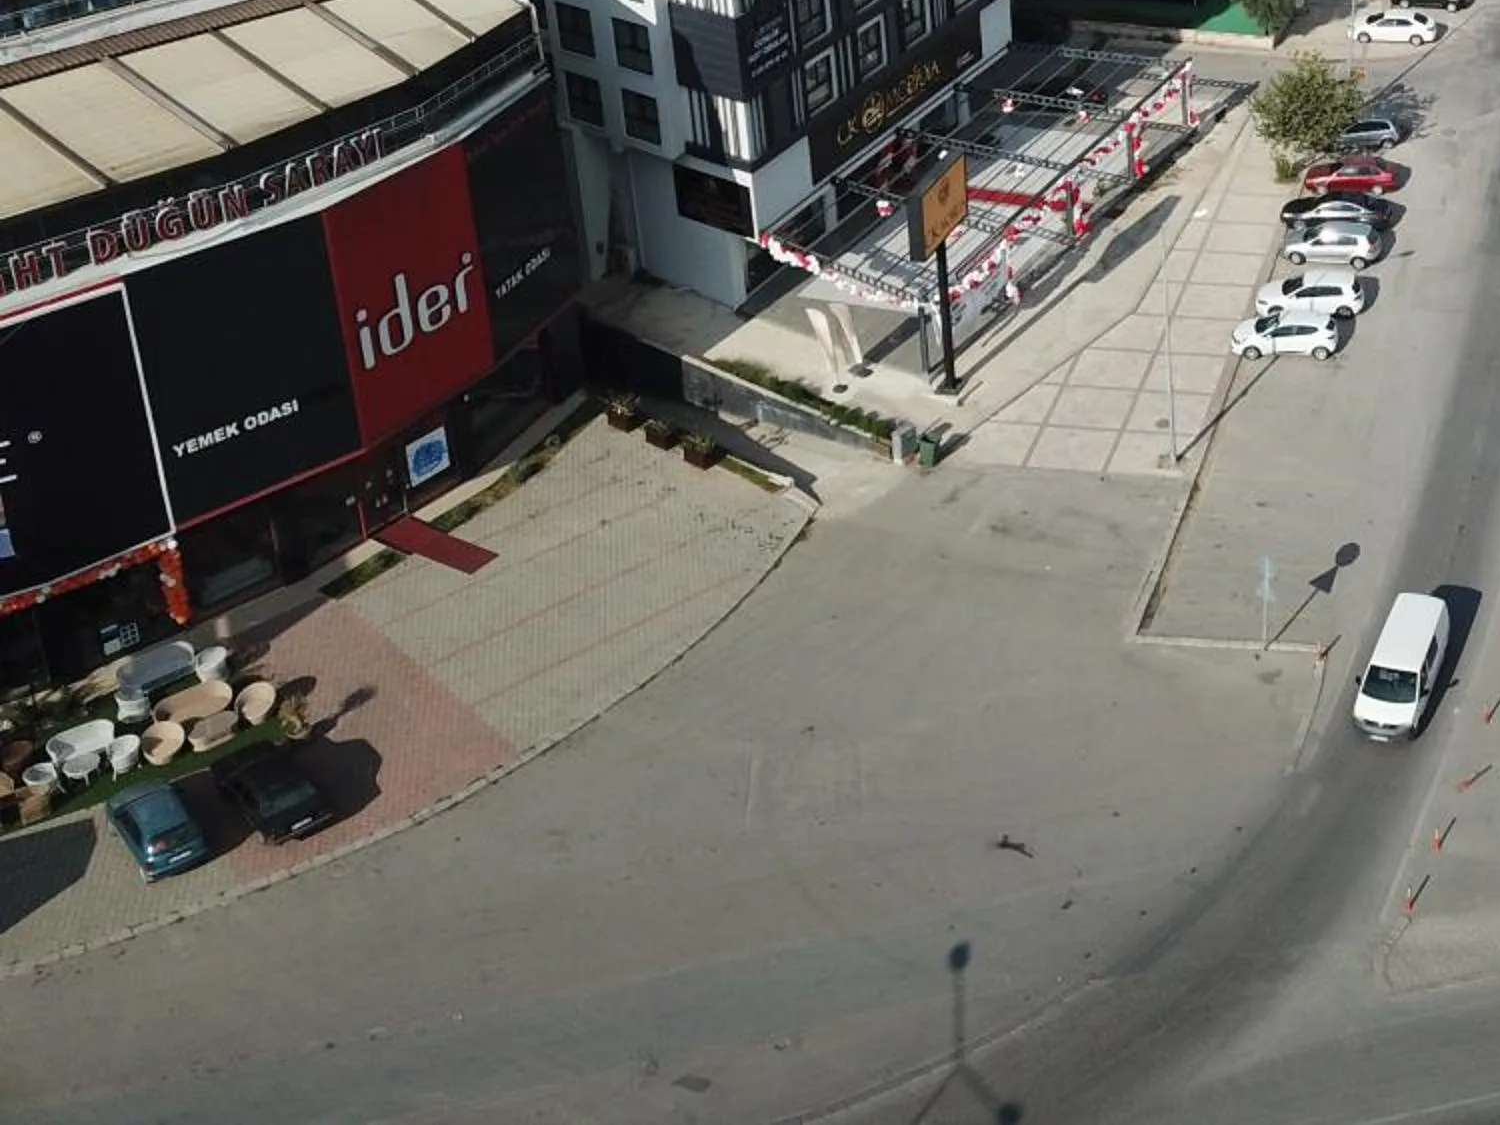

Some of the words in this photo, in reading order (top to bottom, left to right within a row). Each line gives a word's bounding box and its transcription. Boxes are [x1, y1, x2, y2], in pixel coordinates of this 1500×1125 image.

[87, 188, 251, 266] DÜĞÜN
[259, 127, 386, 208] SARAYI
[171, 422, 240, 459] YEMEK
[243, 398, 300, 431] ODASI
